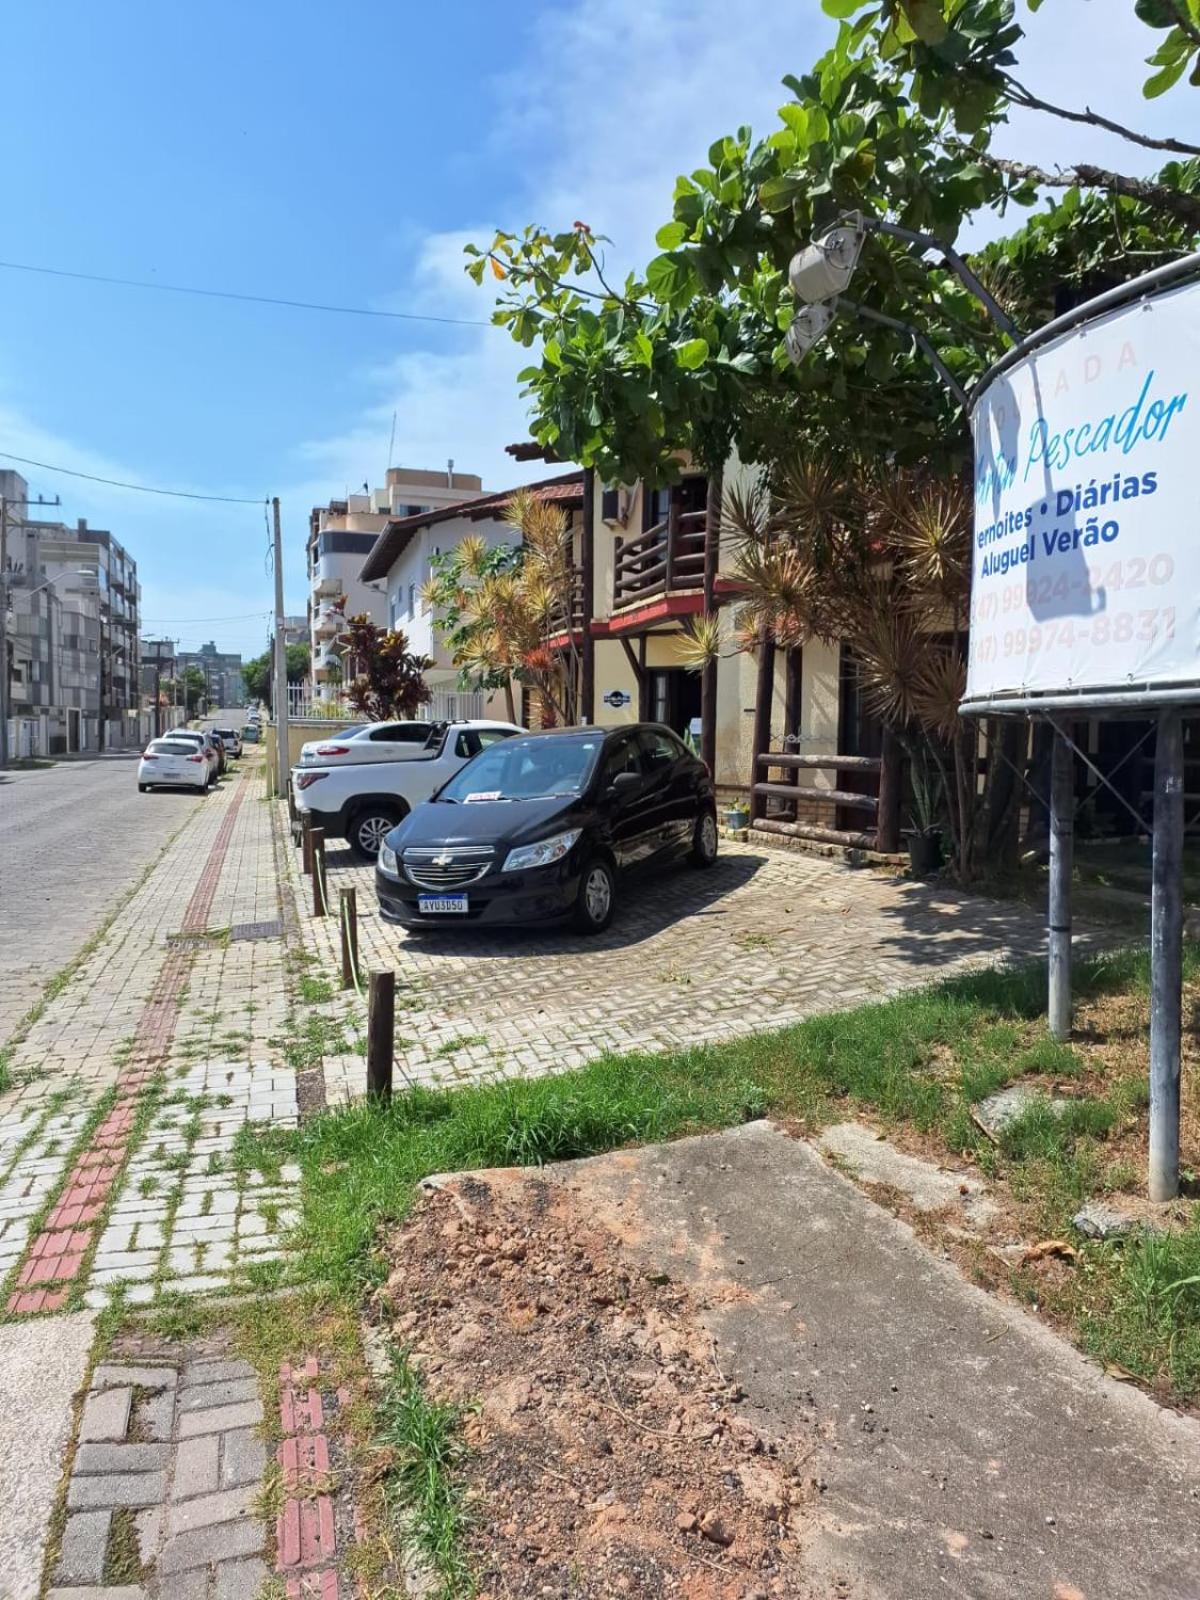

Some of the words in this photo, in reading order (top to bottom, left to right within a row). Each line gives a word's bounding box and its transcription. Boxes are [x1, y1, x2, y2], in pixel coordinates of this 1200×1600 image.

[1024, 368, 1188, 484] Pescador
[977, 507, 1033, 549] ernoites
[1056, 471, 1158, 518] Diárias
[981, 534, 1035, 579] Aluguel
[1042, 516, 1120, 557] Verão
